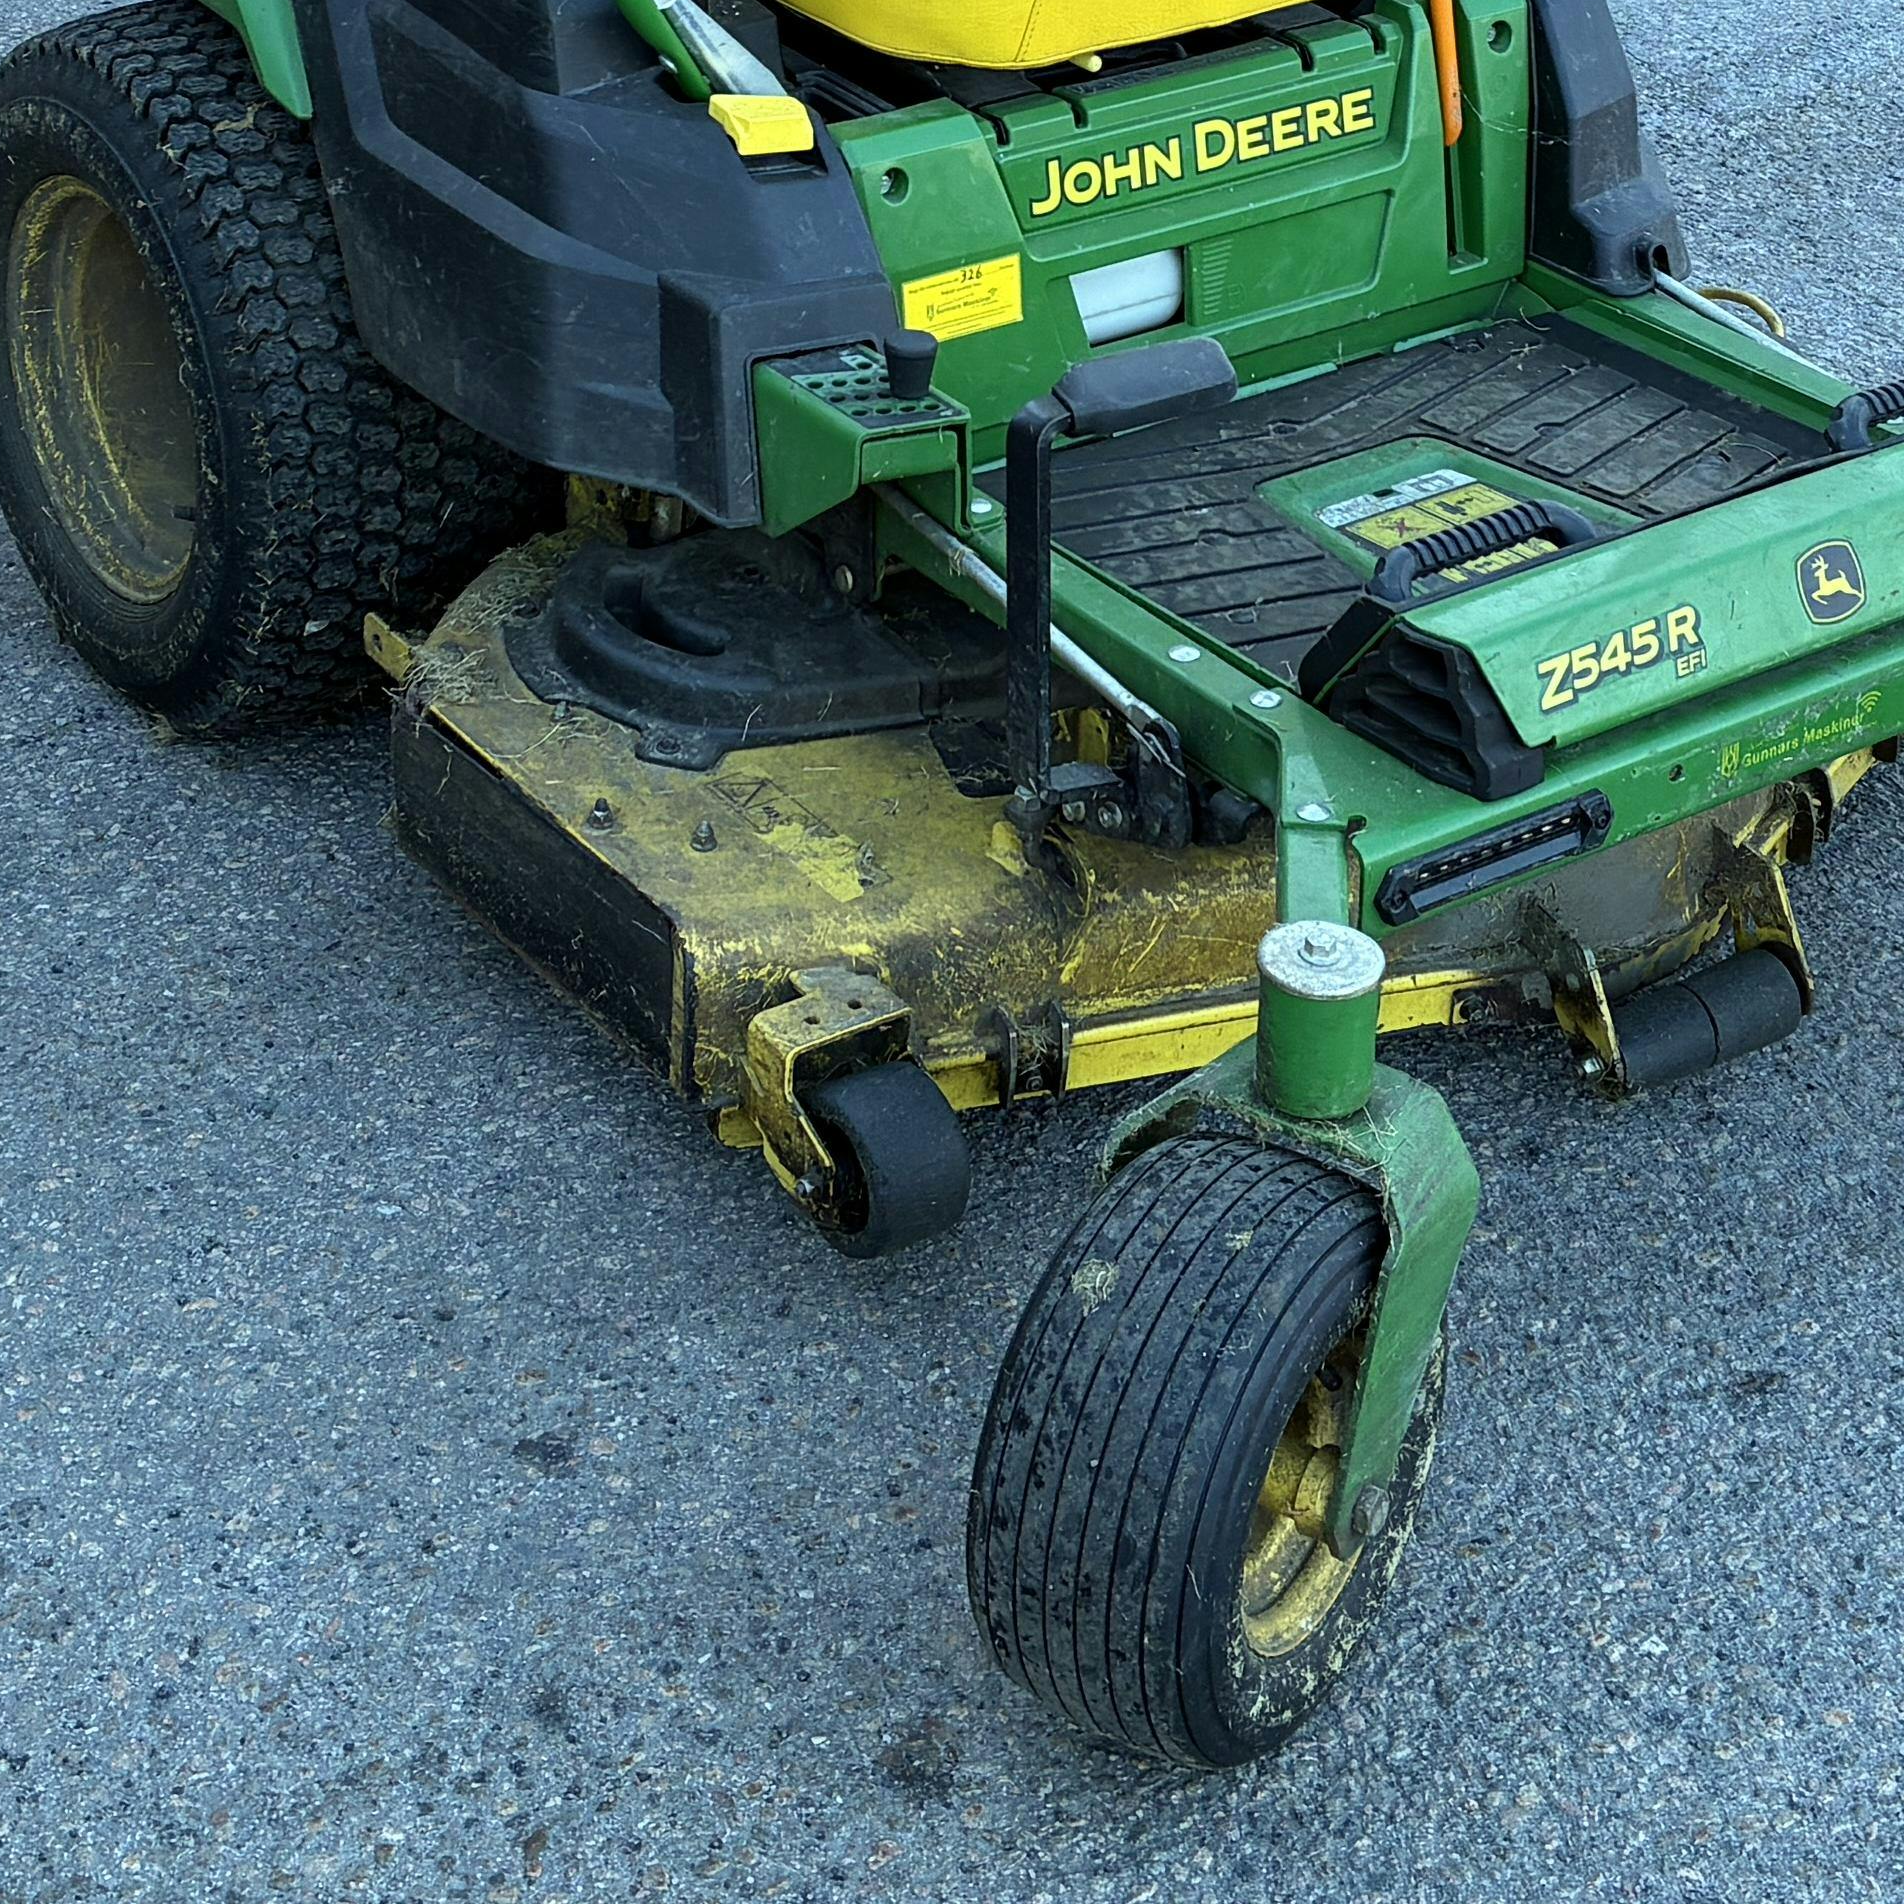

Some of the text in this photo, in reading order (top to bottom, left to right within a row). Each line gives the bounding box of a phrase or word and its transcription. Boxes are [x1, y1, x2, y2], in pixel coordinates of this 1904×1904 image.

[1030, 87, 1375, 217] JOHN DEERE
[959, 265, 983, 284] 326
[1537, 604, 1700, 712] Z545 R
[1676, 648, 1707, 678] EFI
[1740, 735, 1800, 768] Gunnars
